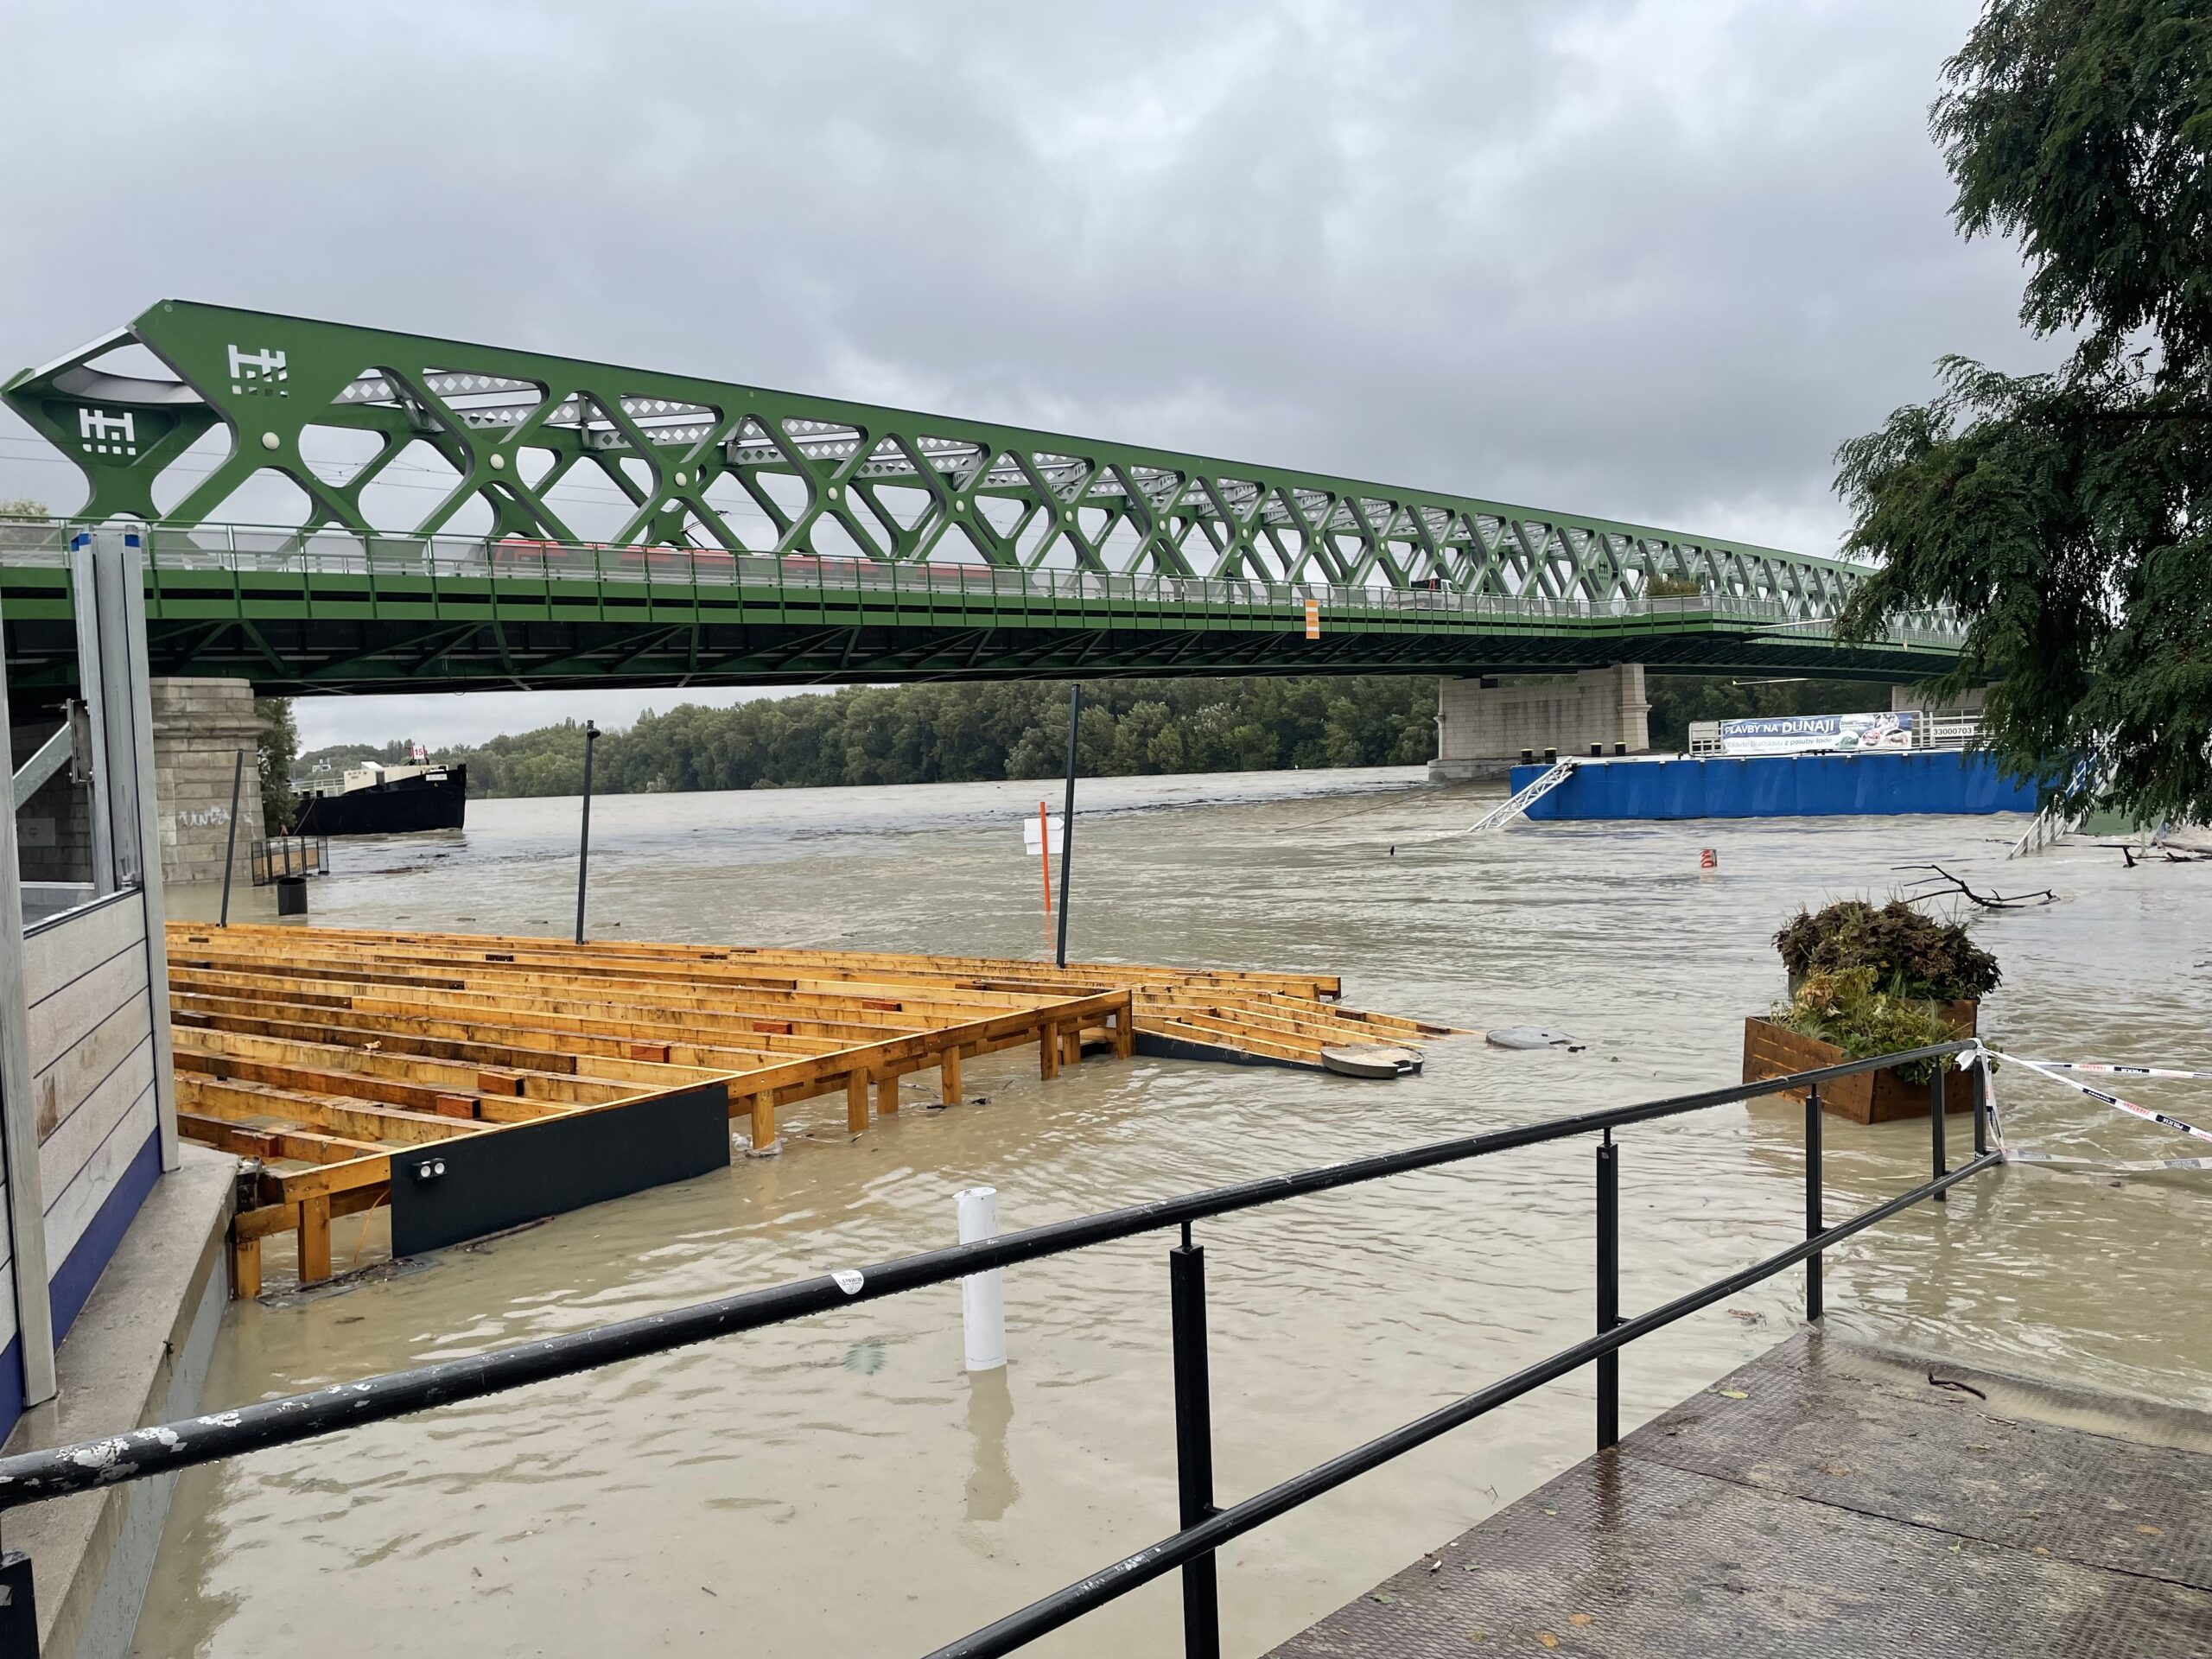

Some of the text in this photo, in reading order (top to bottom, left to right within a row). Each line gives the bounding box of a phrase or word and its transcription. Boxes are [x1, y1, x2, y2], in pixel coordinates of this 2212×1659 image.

[1725, 720, 1834, 734] PLAVBY NA DUNAJI
